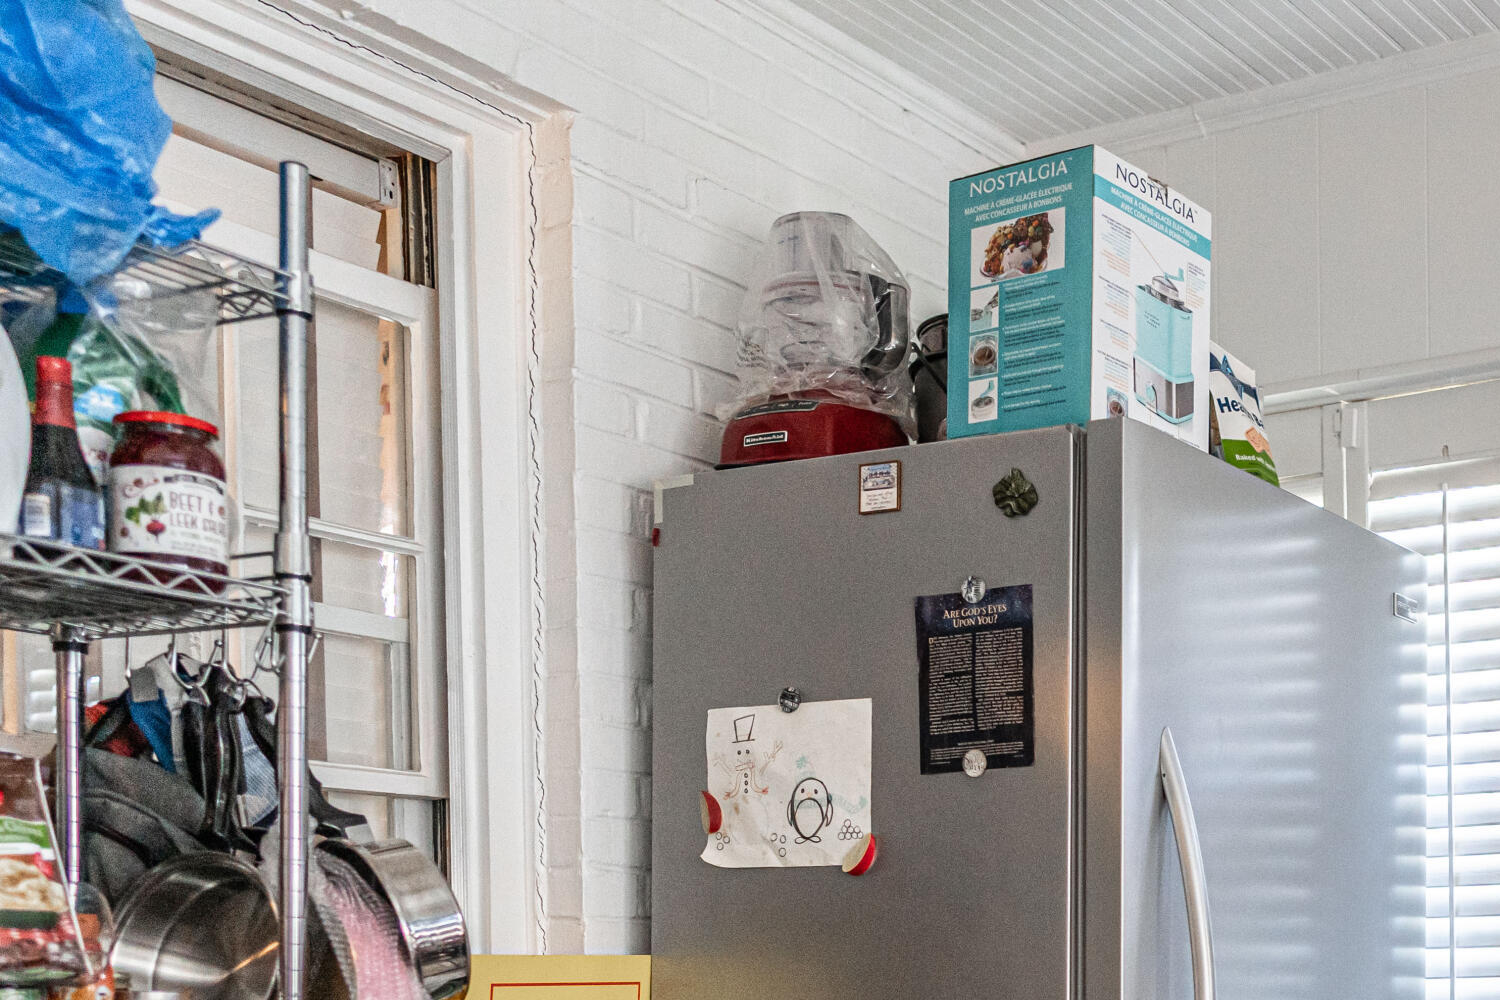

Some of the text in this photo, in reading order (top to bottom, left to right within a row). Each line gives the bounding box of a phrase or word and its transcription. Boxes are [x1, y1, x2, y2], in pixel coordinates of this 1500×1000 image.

[969, 158, 1069, 198] NOSTALGIA
[1110, 186, 1132, 205] MACHINE
[1116, 163, 1195, 223] NOSTALGIA
[964, 202, 989, 215] MACHINE
[975, 210, 989, 222] AVEC
[990, 202, 1028, 220] CONCASSEUR
[1120, 202, 1132, 216] AVEC
[170, 491, 202, 514] BEET
[943, 603, 1008, 620] ARE GOD'S EYES
[952, 613, 998, 628] UPON YOU?
